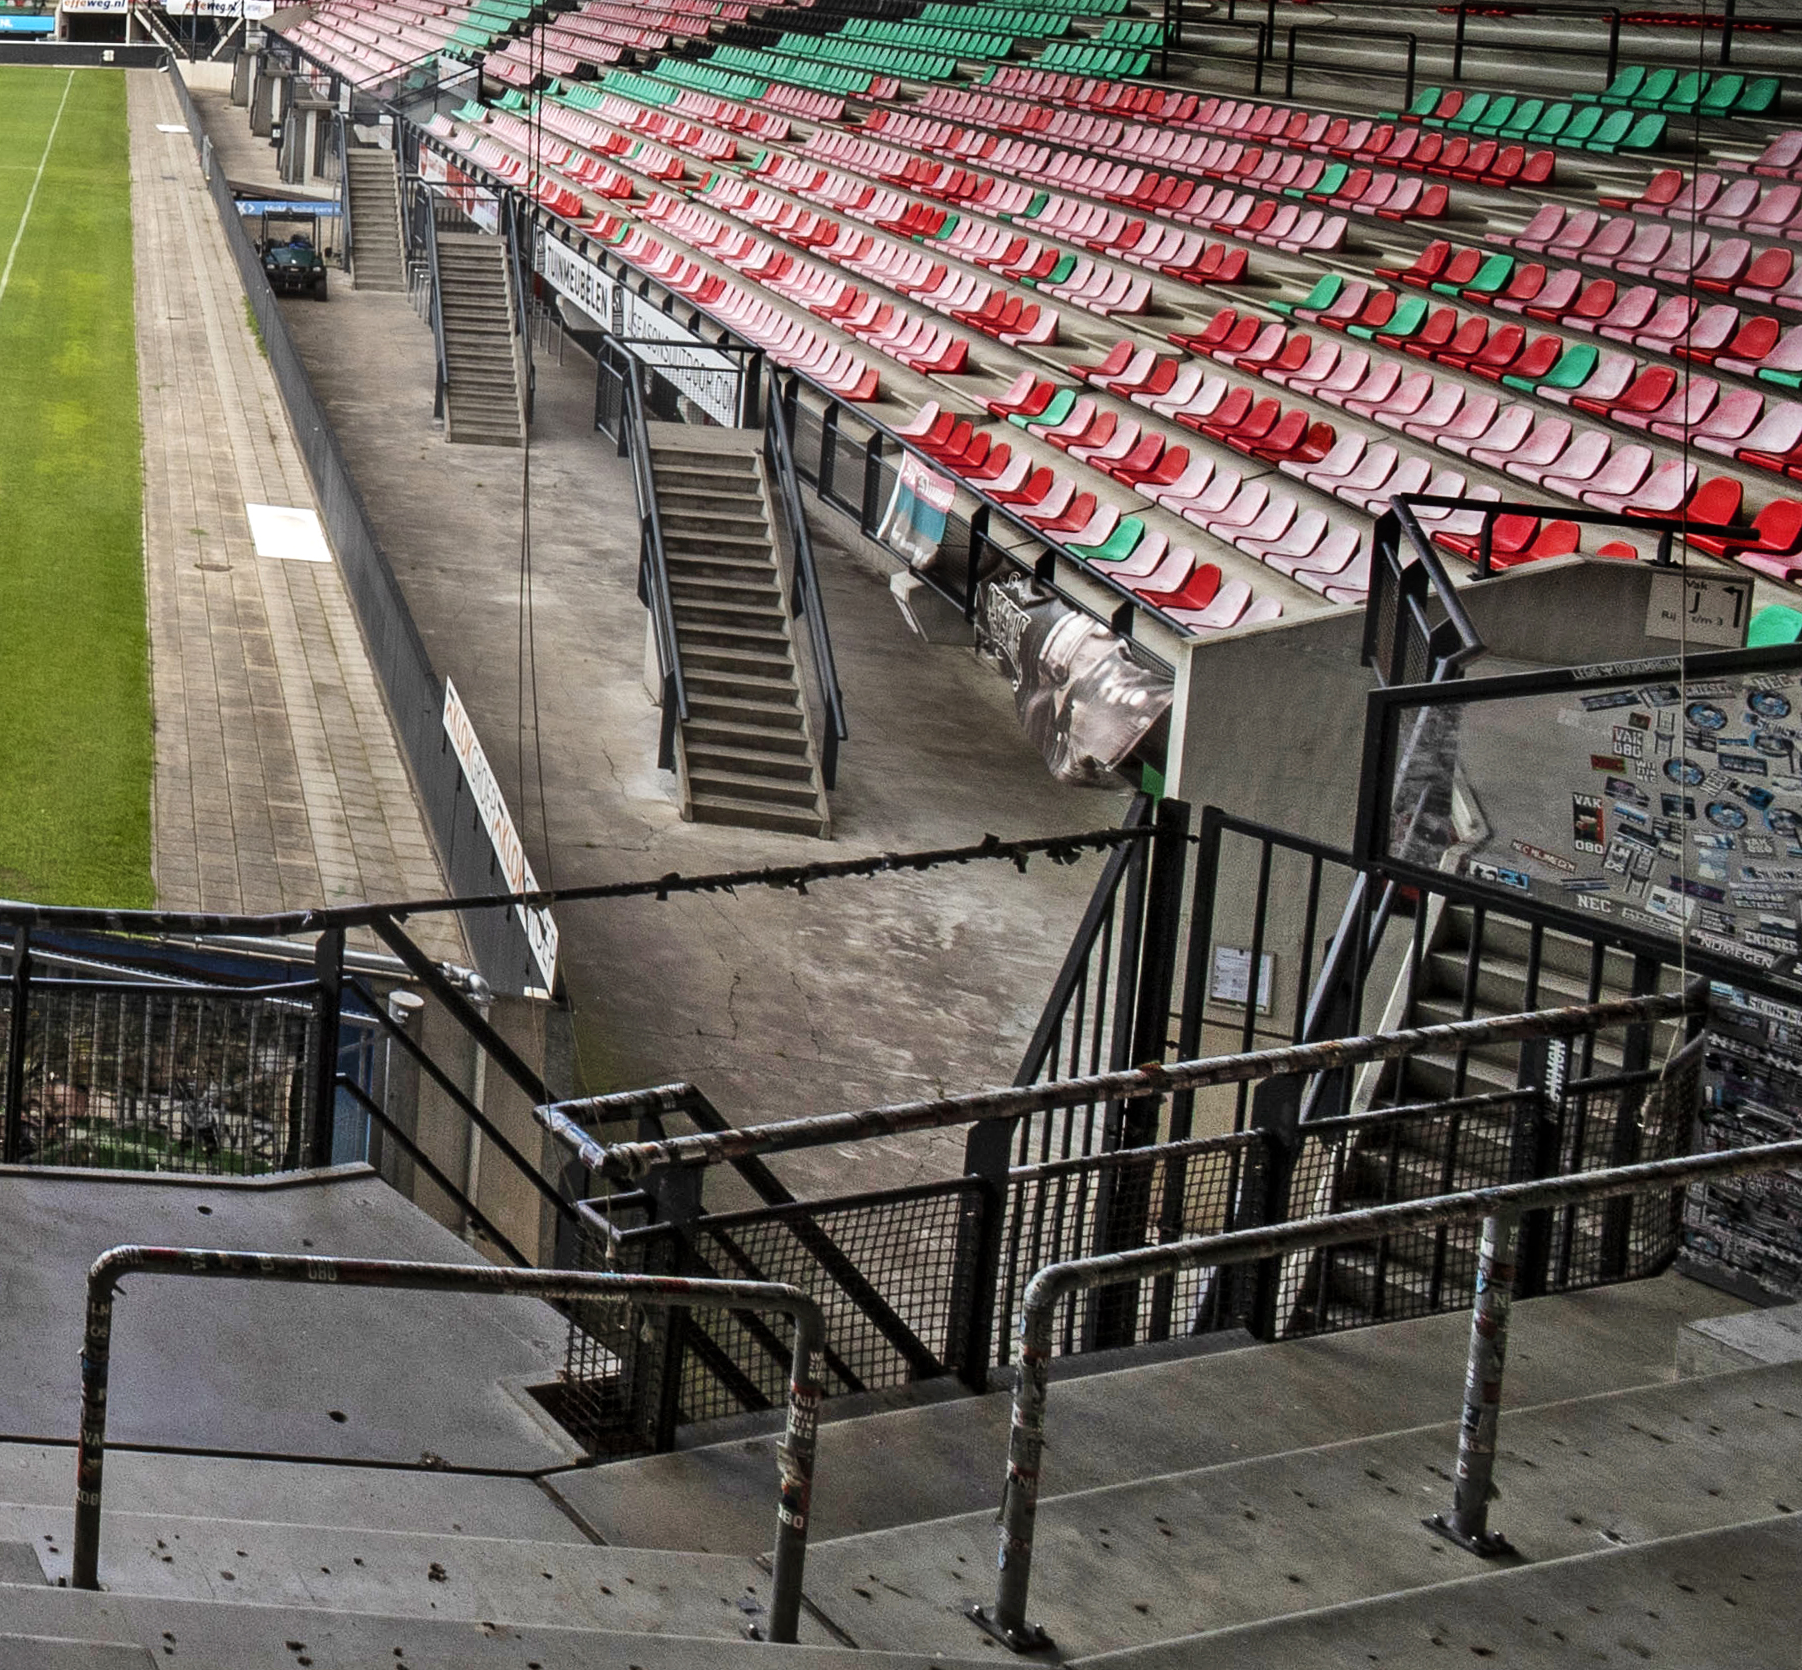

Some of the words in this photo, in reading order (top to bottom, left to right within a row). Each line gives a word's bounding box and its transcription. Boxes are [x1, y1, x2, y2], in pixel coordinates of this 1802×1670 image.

[547, 245, 608, 320] TUINMEUBELEN
[1614, 729, 1644, 747] VAK
[1573, 793, 1603, 809] VAK
[1577, 893, 1612, 914] NEC
